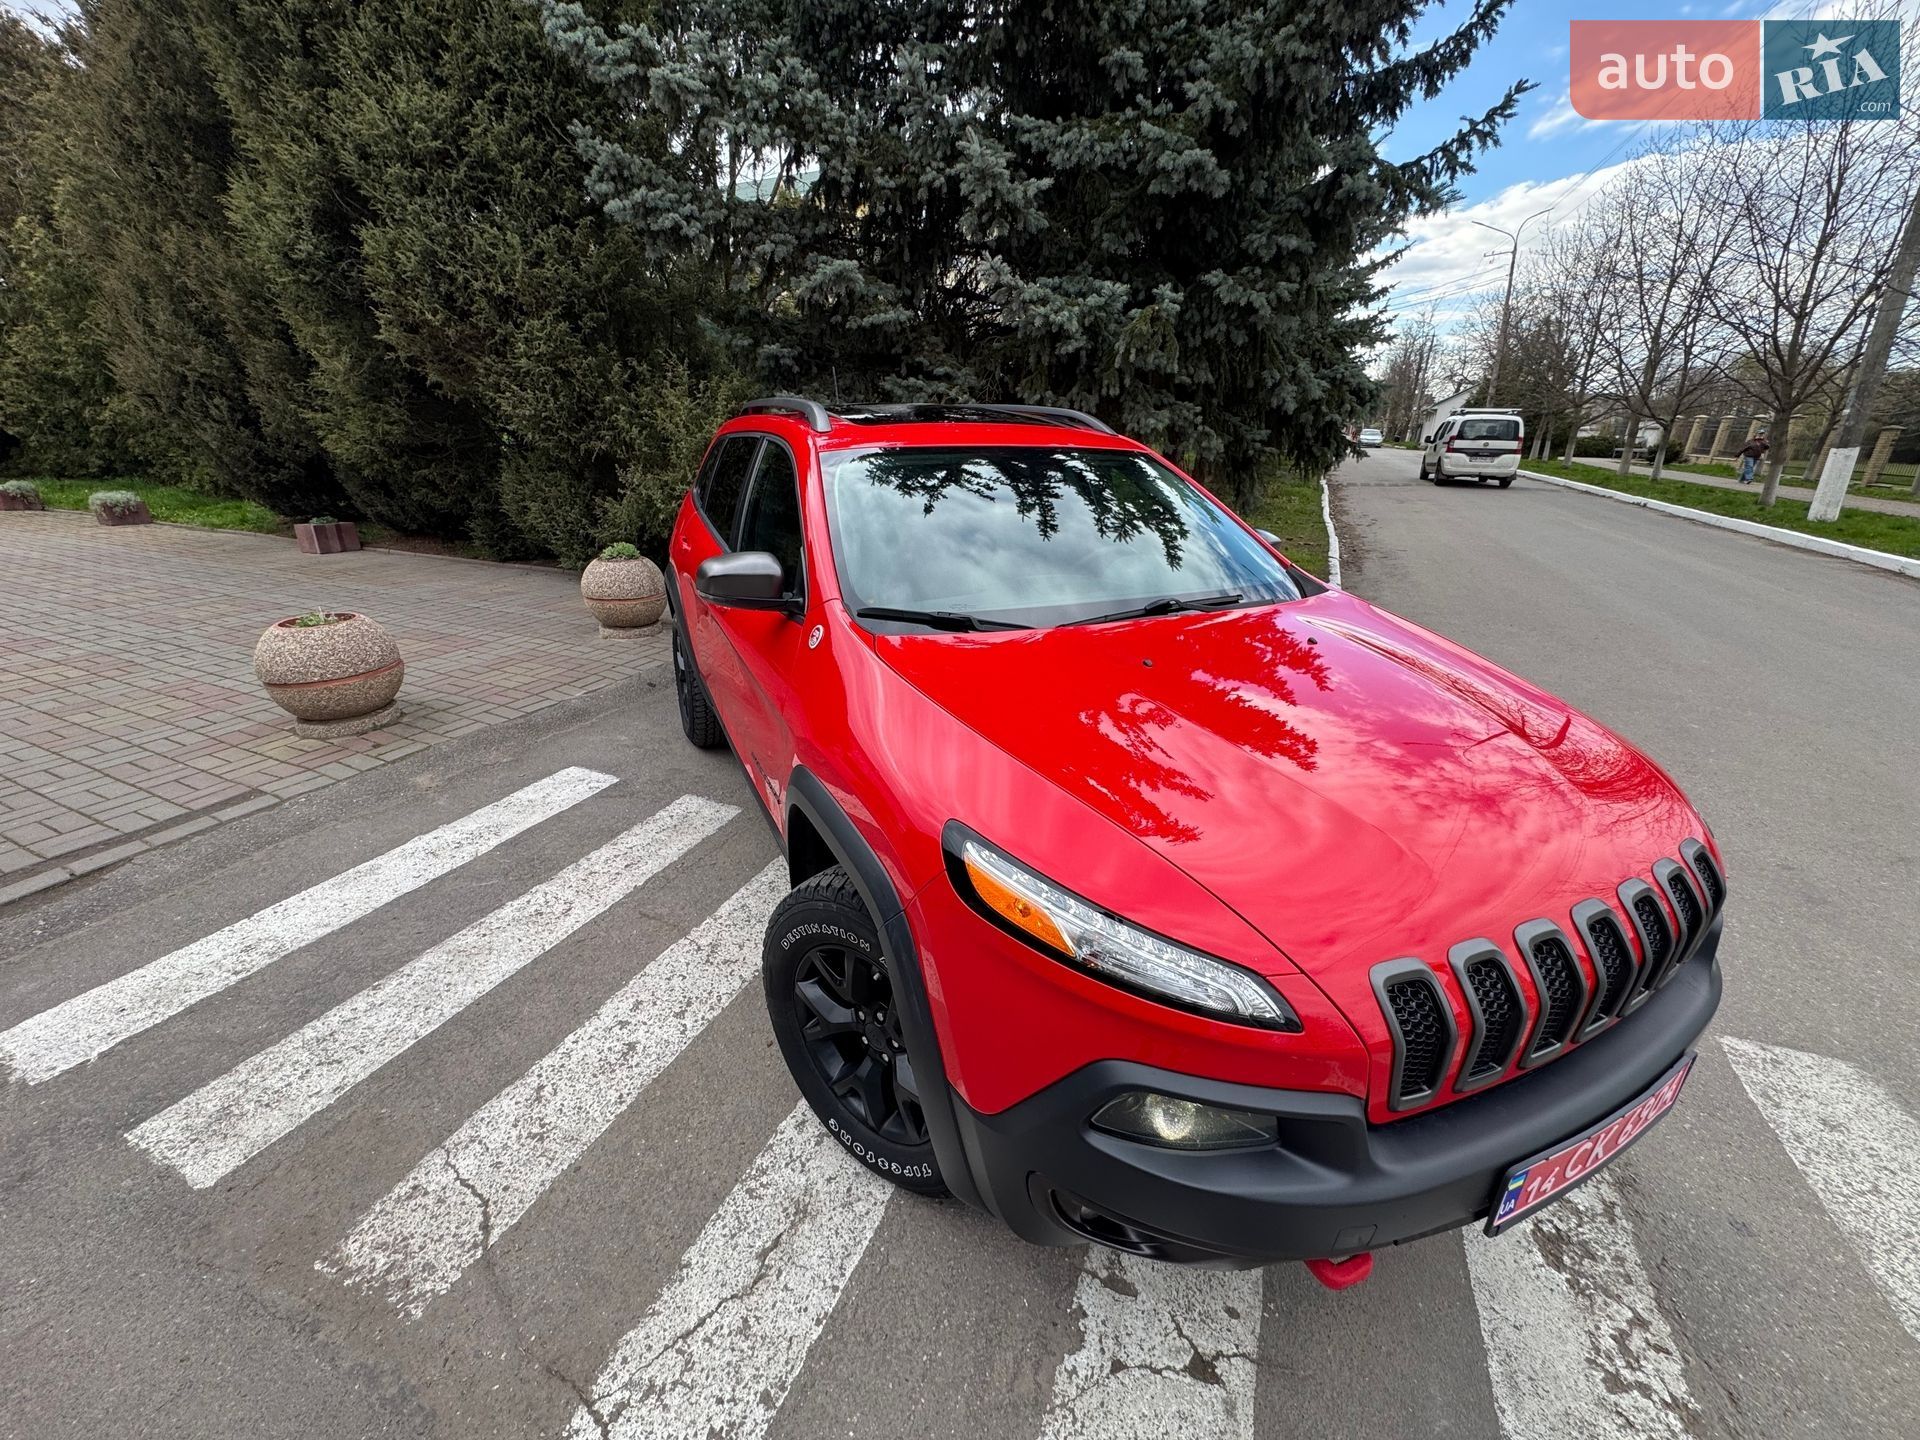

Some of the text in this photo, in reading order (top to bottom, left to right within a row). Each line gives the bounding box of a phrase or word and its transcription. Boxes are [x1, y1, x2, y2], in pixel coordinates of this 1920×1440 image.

[780, 923, 871, 952] DESTINATION
[828, 1117, 932, 1178] Firestone
[1526, 1166, 1560, 1203] 14
[1564, 1124, 1619, 1179] CK
[1499, 1198, 1515, 1215] UA
